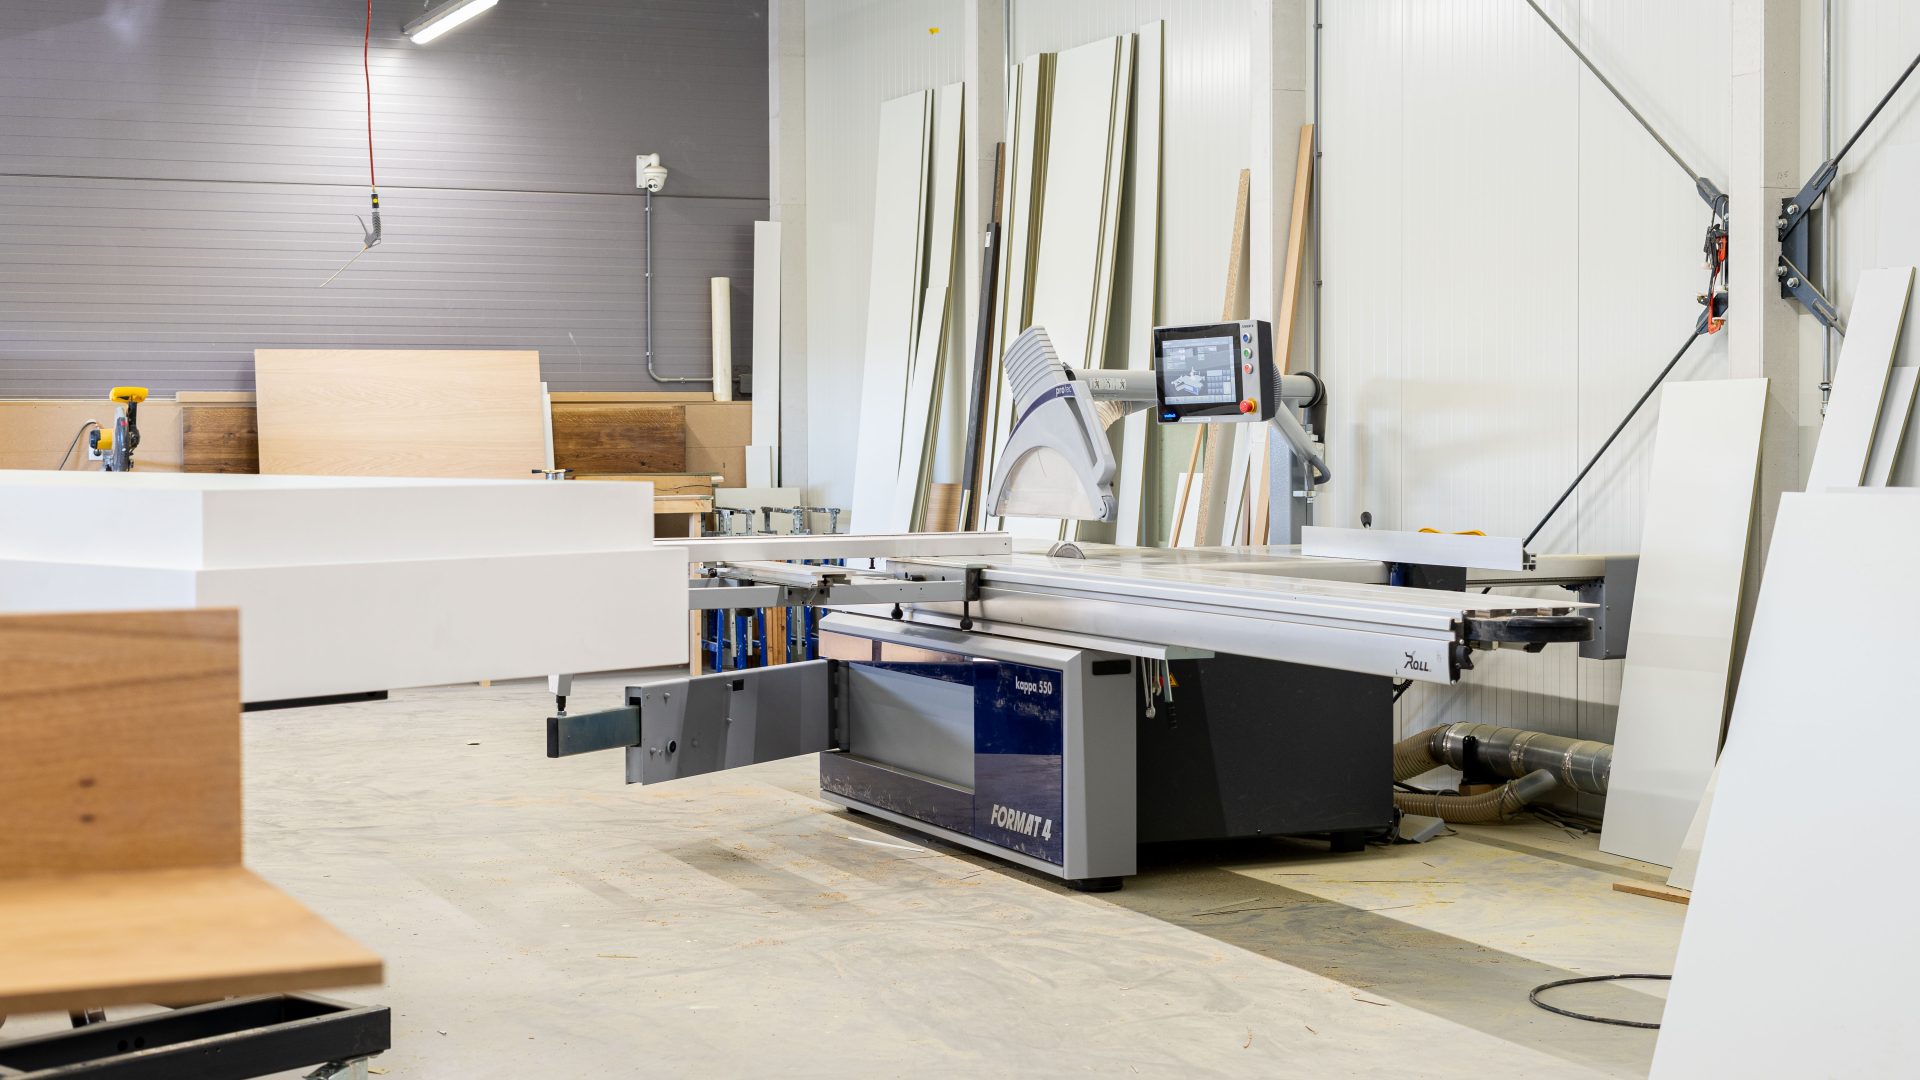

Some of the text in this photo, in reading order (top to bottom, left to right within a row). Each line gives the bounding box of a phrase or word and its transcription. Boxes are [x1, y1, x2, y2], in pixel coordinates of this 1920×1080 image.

[1015, 675, 1053, 695] kappa 550
[990, 804, 1053, 841] FORMAT 4
